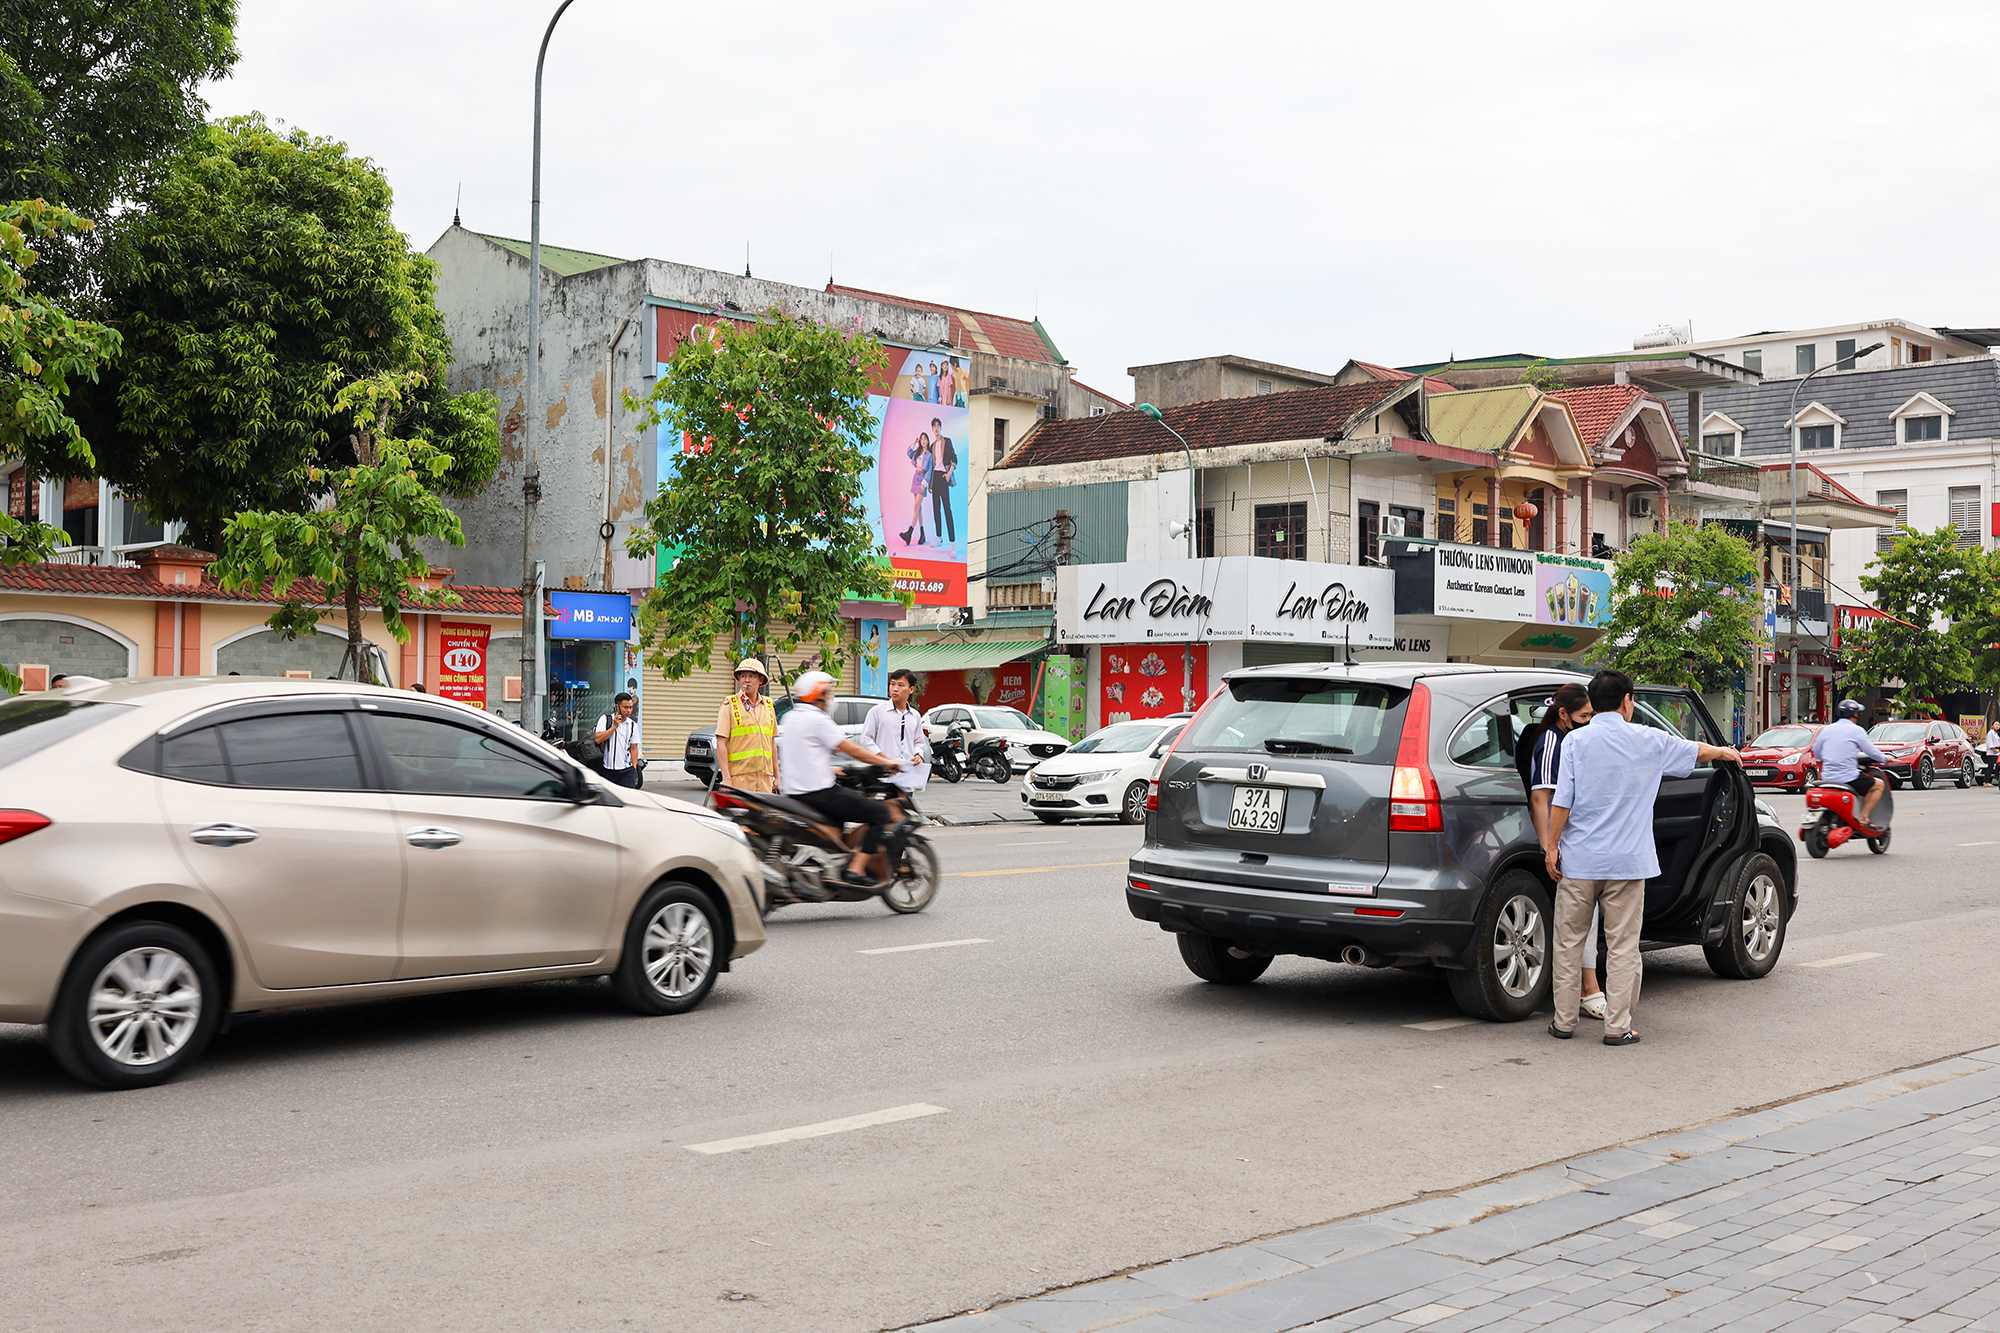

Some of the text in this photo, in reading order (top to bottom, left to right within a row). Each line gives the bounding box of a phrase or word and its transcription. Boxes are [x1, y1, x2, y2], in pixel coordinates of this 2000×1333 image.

[1439, 549, 1533, 575] THƯƠNG LENS VIVIMOON
[1446, 579, 1526, 597] Authentic Korean Contact Lens
[1083, 578, 1212, 621] Lan Đàm
[1276, 580, 1370, 622] Lan Đàm
[573, 609, 624, 624] MB ATM 24/7
[1408, 638, 1431, 653] LENS
[449, 653, 477, 668] 140
[1003, 676, 1022, 686] KEM
[998, 688, 1026, 700] Merino
[1966, 727, 1980, 736] C3
[1244, 788, 1270, 808] 37A
[1231, 808, 1279, 830] 043.29
